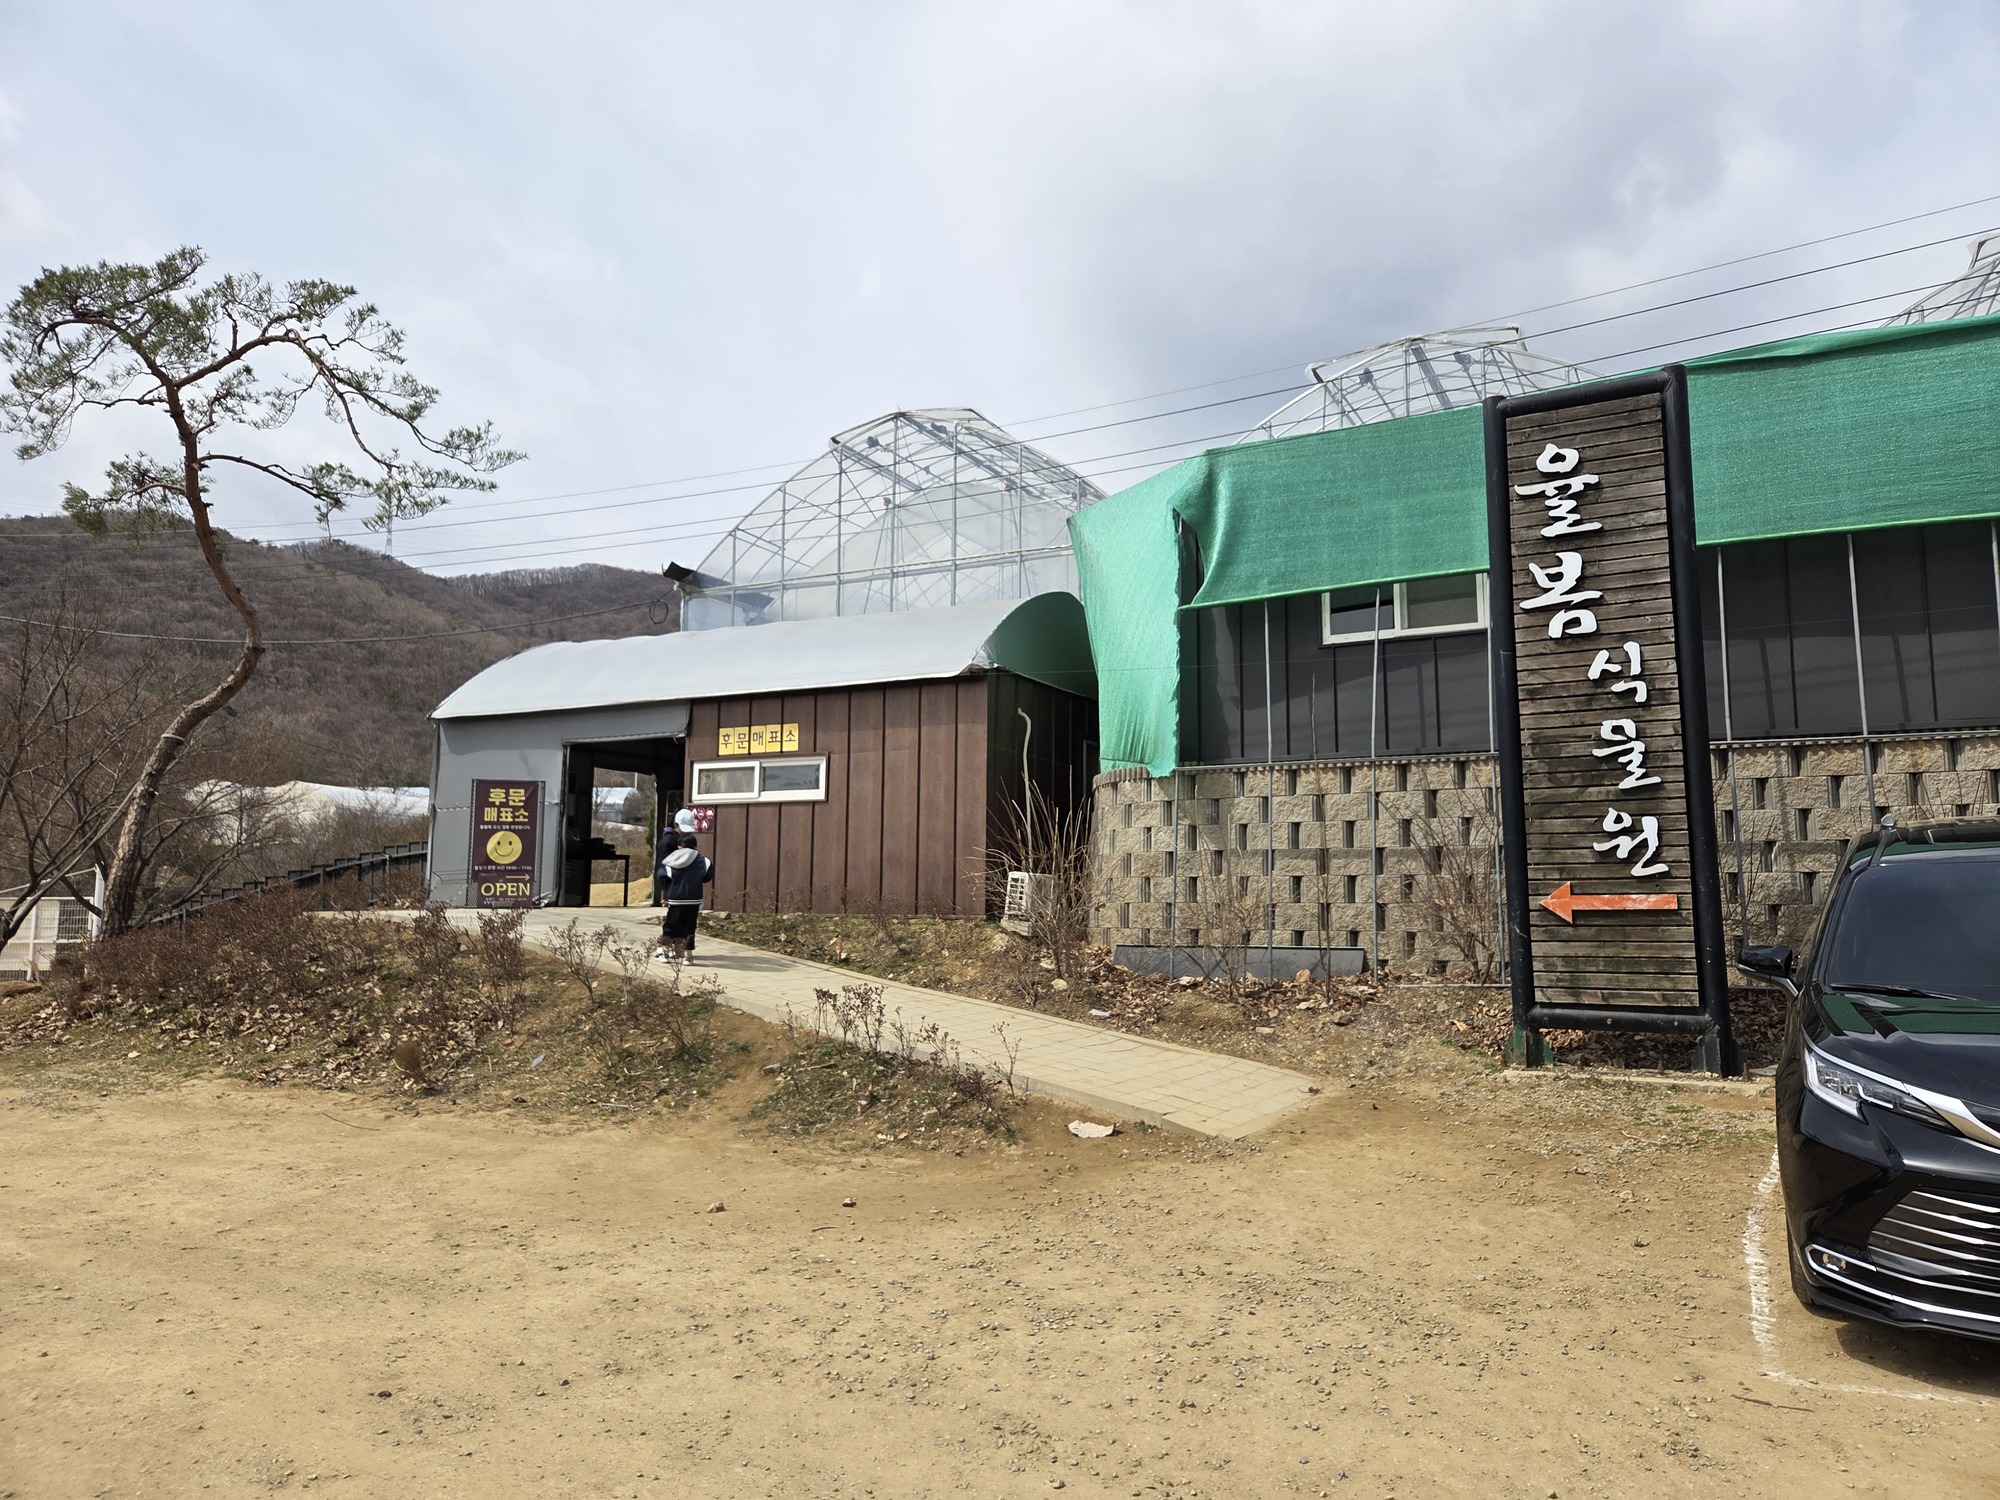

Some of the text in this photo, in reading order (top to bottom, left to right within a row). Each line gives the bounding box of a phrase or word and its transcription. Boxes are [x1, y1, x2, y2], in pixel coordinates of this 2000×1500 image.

[1514, 443, 1668, 876] 율봄 식물원
[488, 788, 526, 806] 후문
[484, 807, 529, 822] 매표소
[481, 883, 530, 896] OPEN
